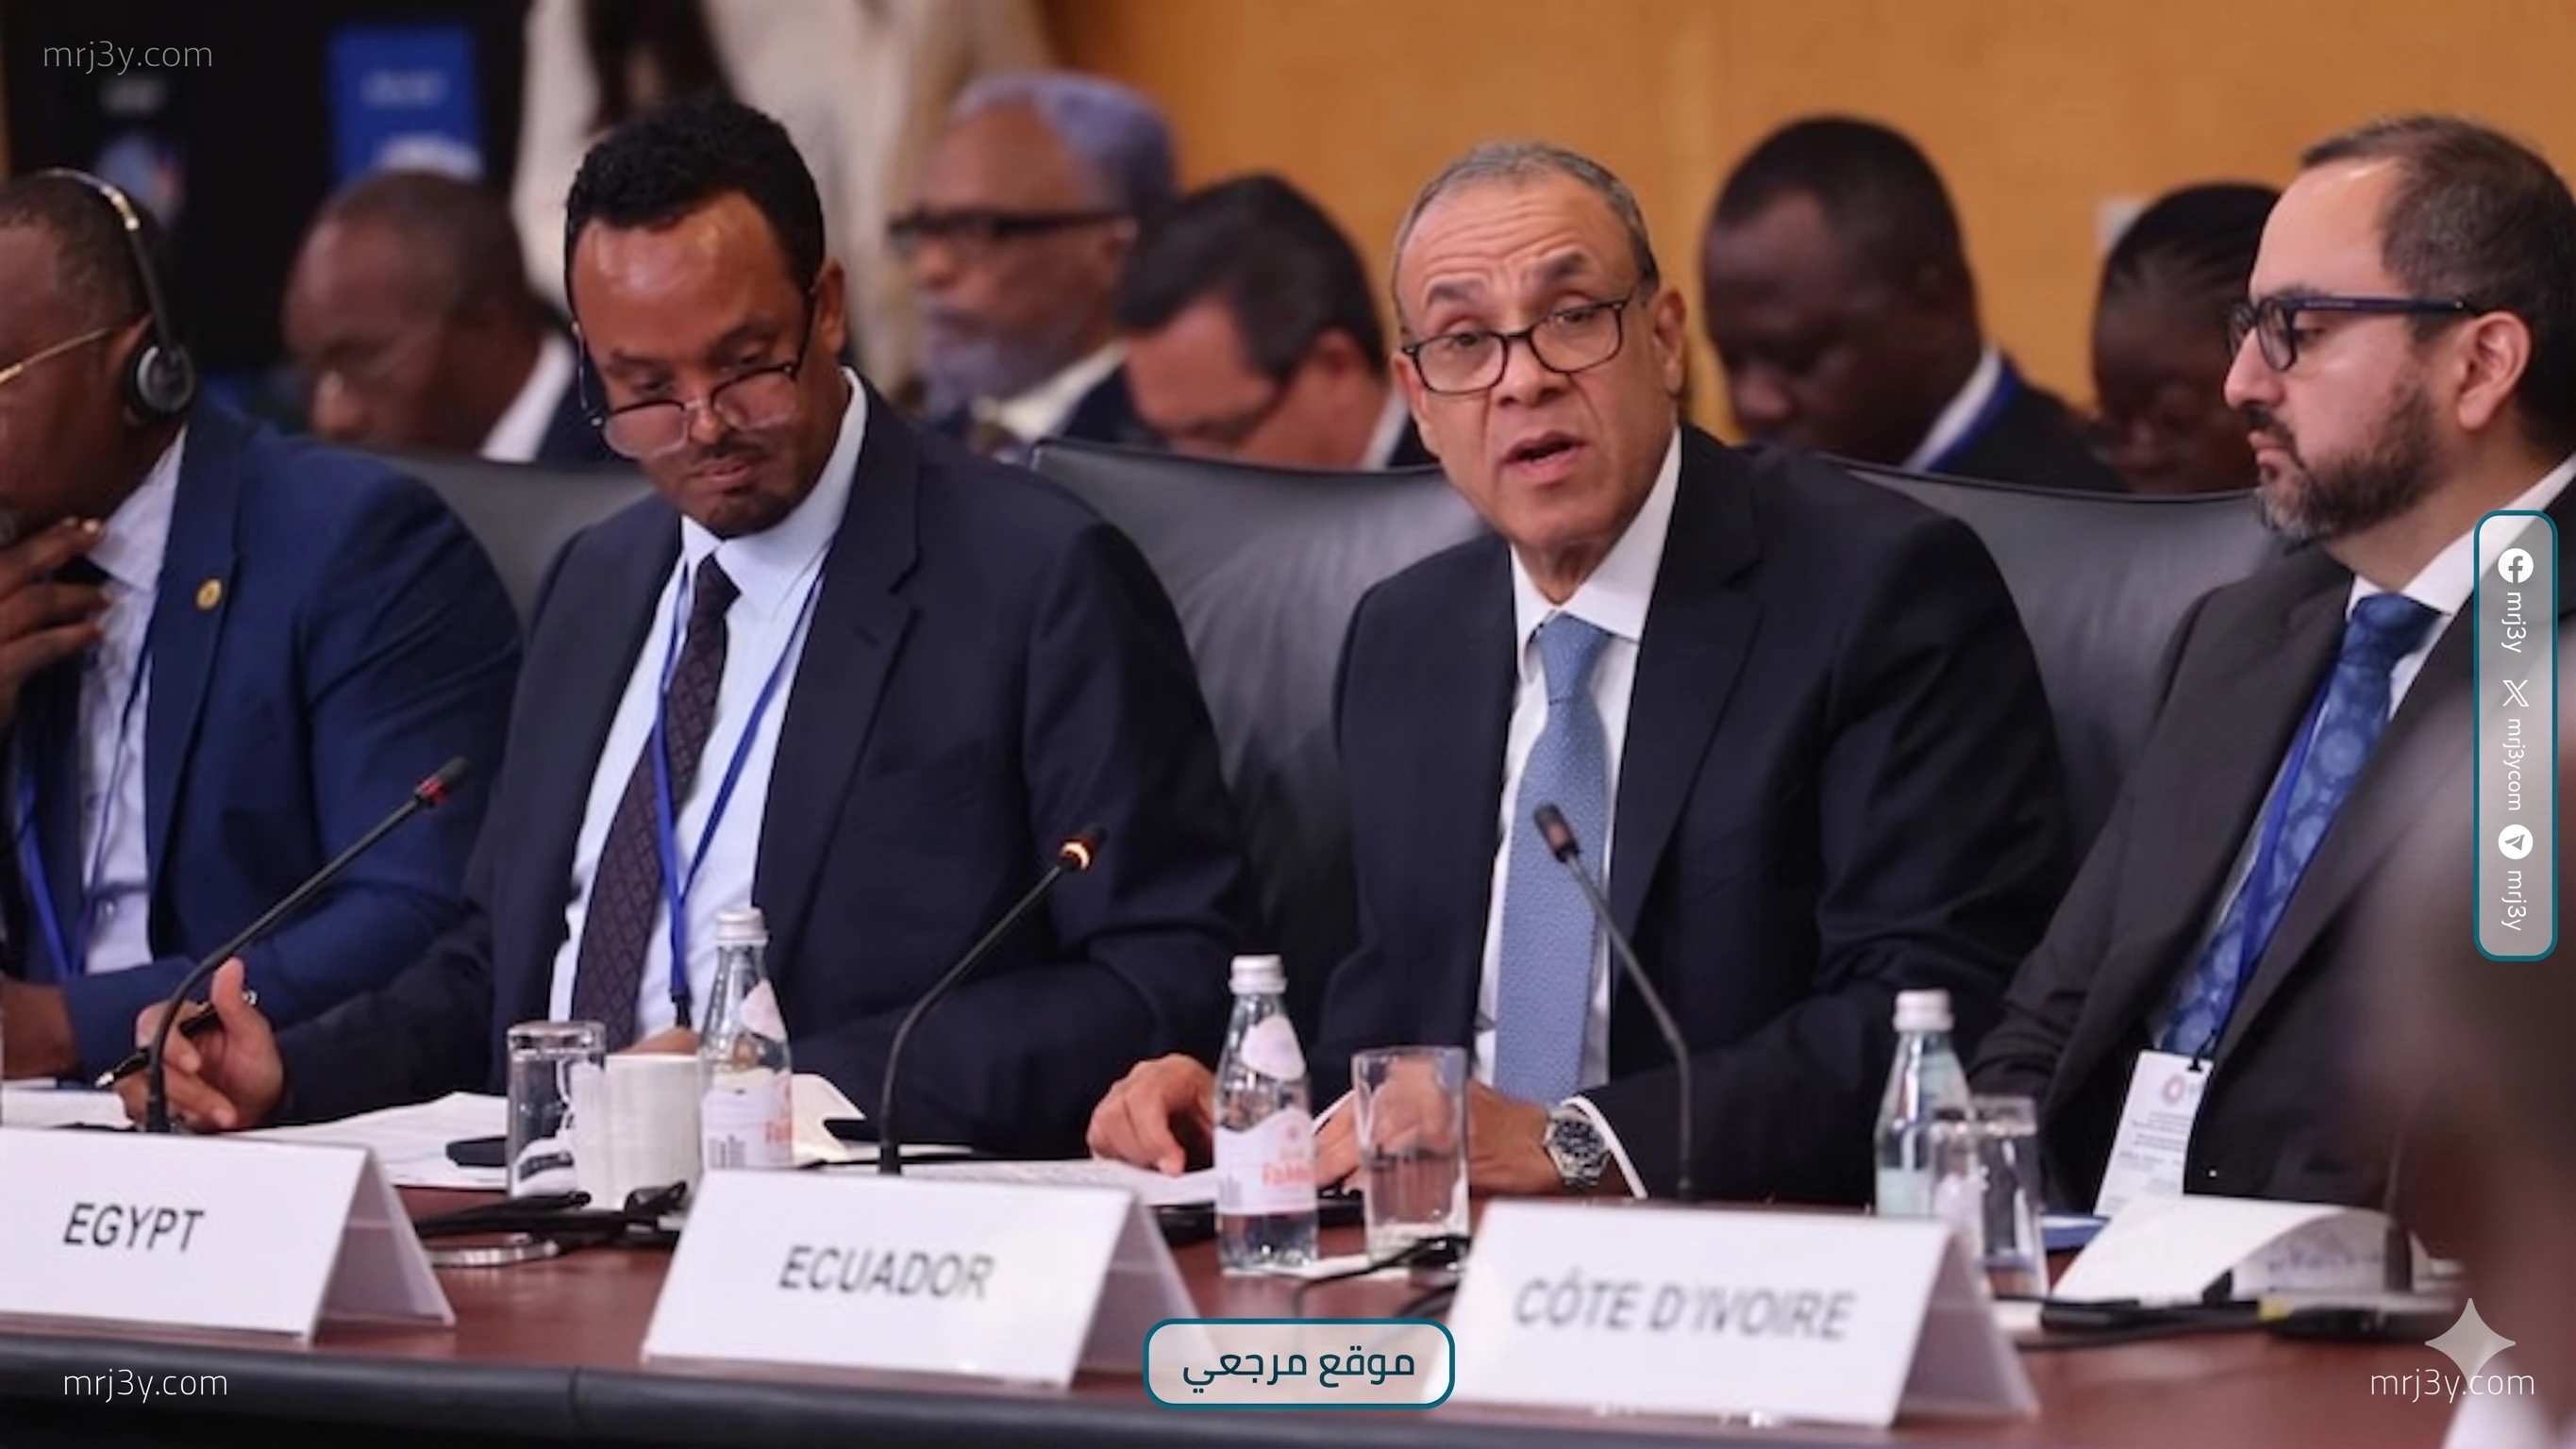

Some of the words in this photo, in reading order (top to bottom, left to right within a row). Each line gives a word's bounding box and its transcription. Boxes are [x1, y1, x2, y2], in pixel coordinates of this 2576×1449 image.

[62, 1202, 206, 1252] EGYPT
[778, 1244, 995, 1300] ECUADOR
[1512, 1266, 1643, 1331] CÔTE
